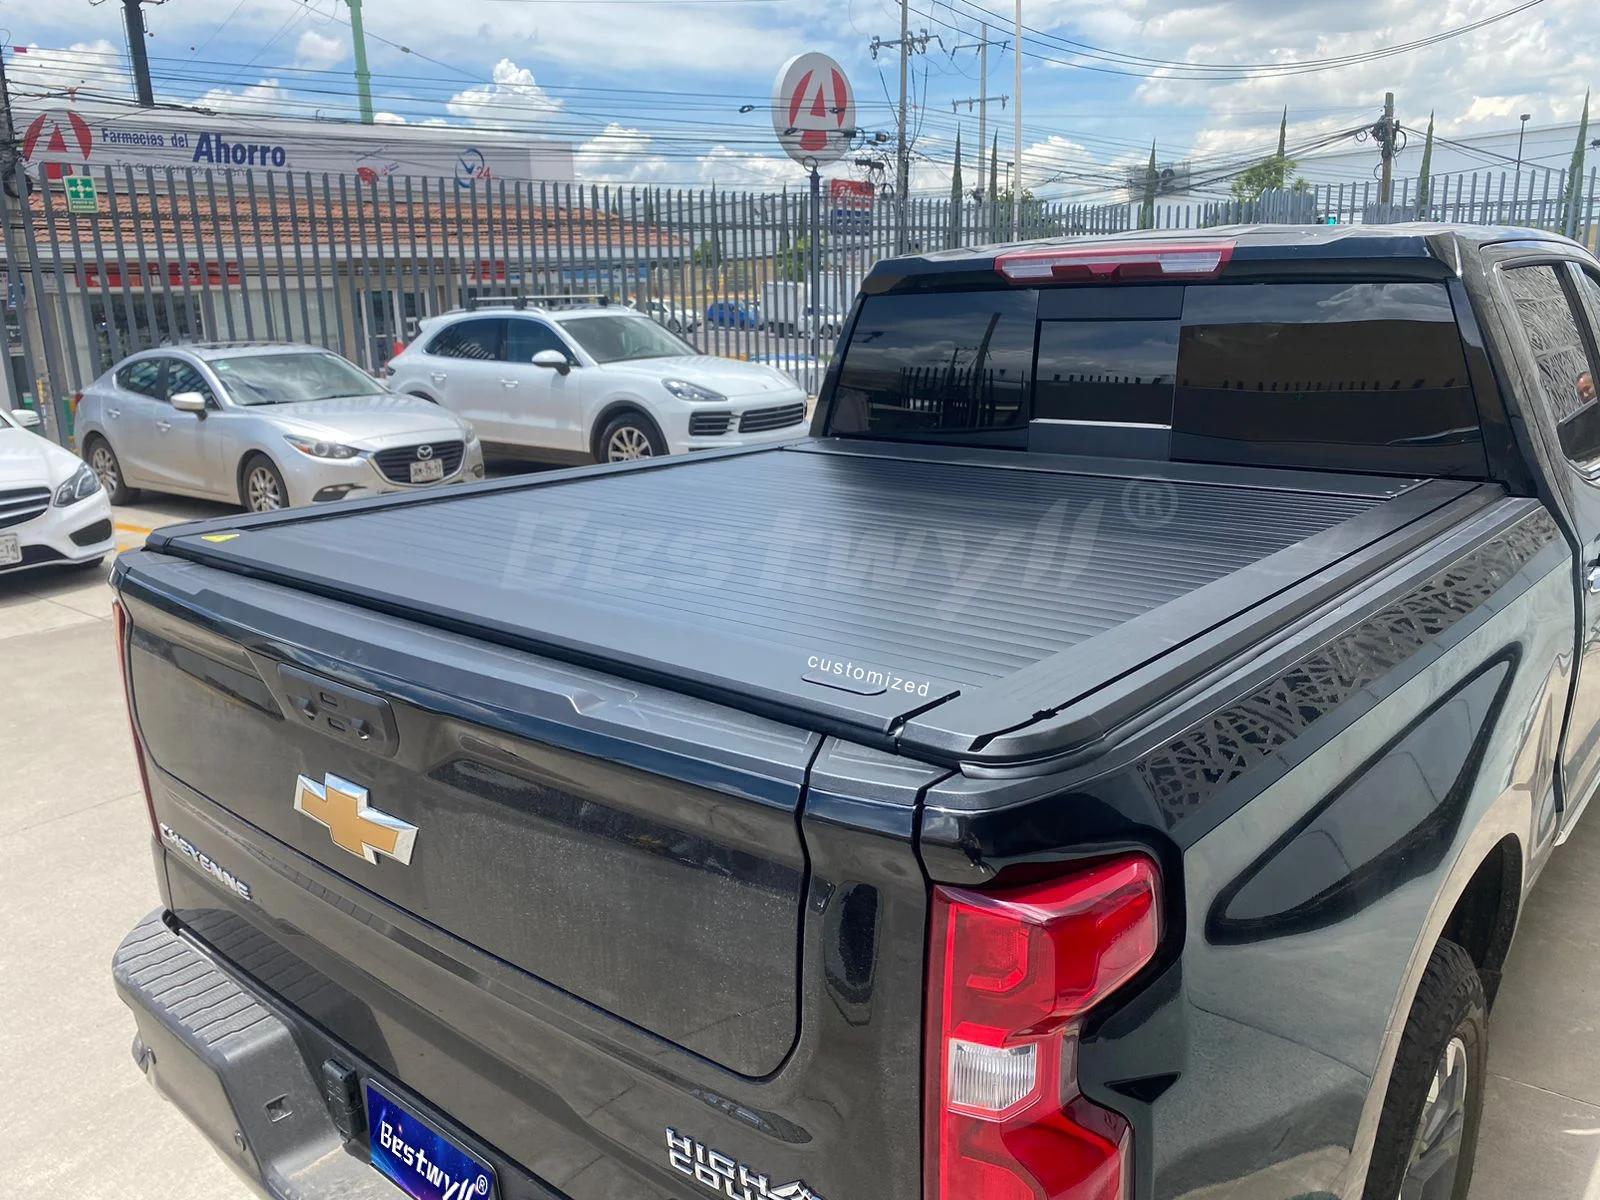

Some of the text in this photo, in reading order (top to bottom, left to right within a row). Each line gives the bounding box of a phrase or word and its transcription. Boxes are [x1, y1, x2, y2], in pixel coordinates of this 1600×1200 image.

[102, 127, 188, 148] Farmacias del
[192, 132, 286, 167] Ahorro
[477, 166, 491, 179] 24
[160, 822, 251, 900] CHEYENNE
[665, 1127, 768, 1197] HIGH
